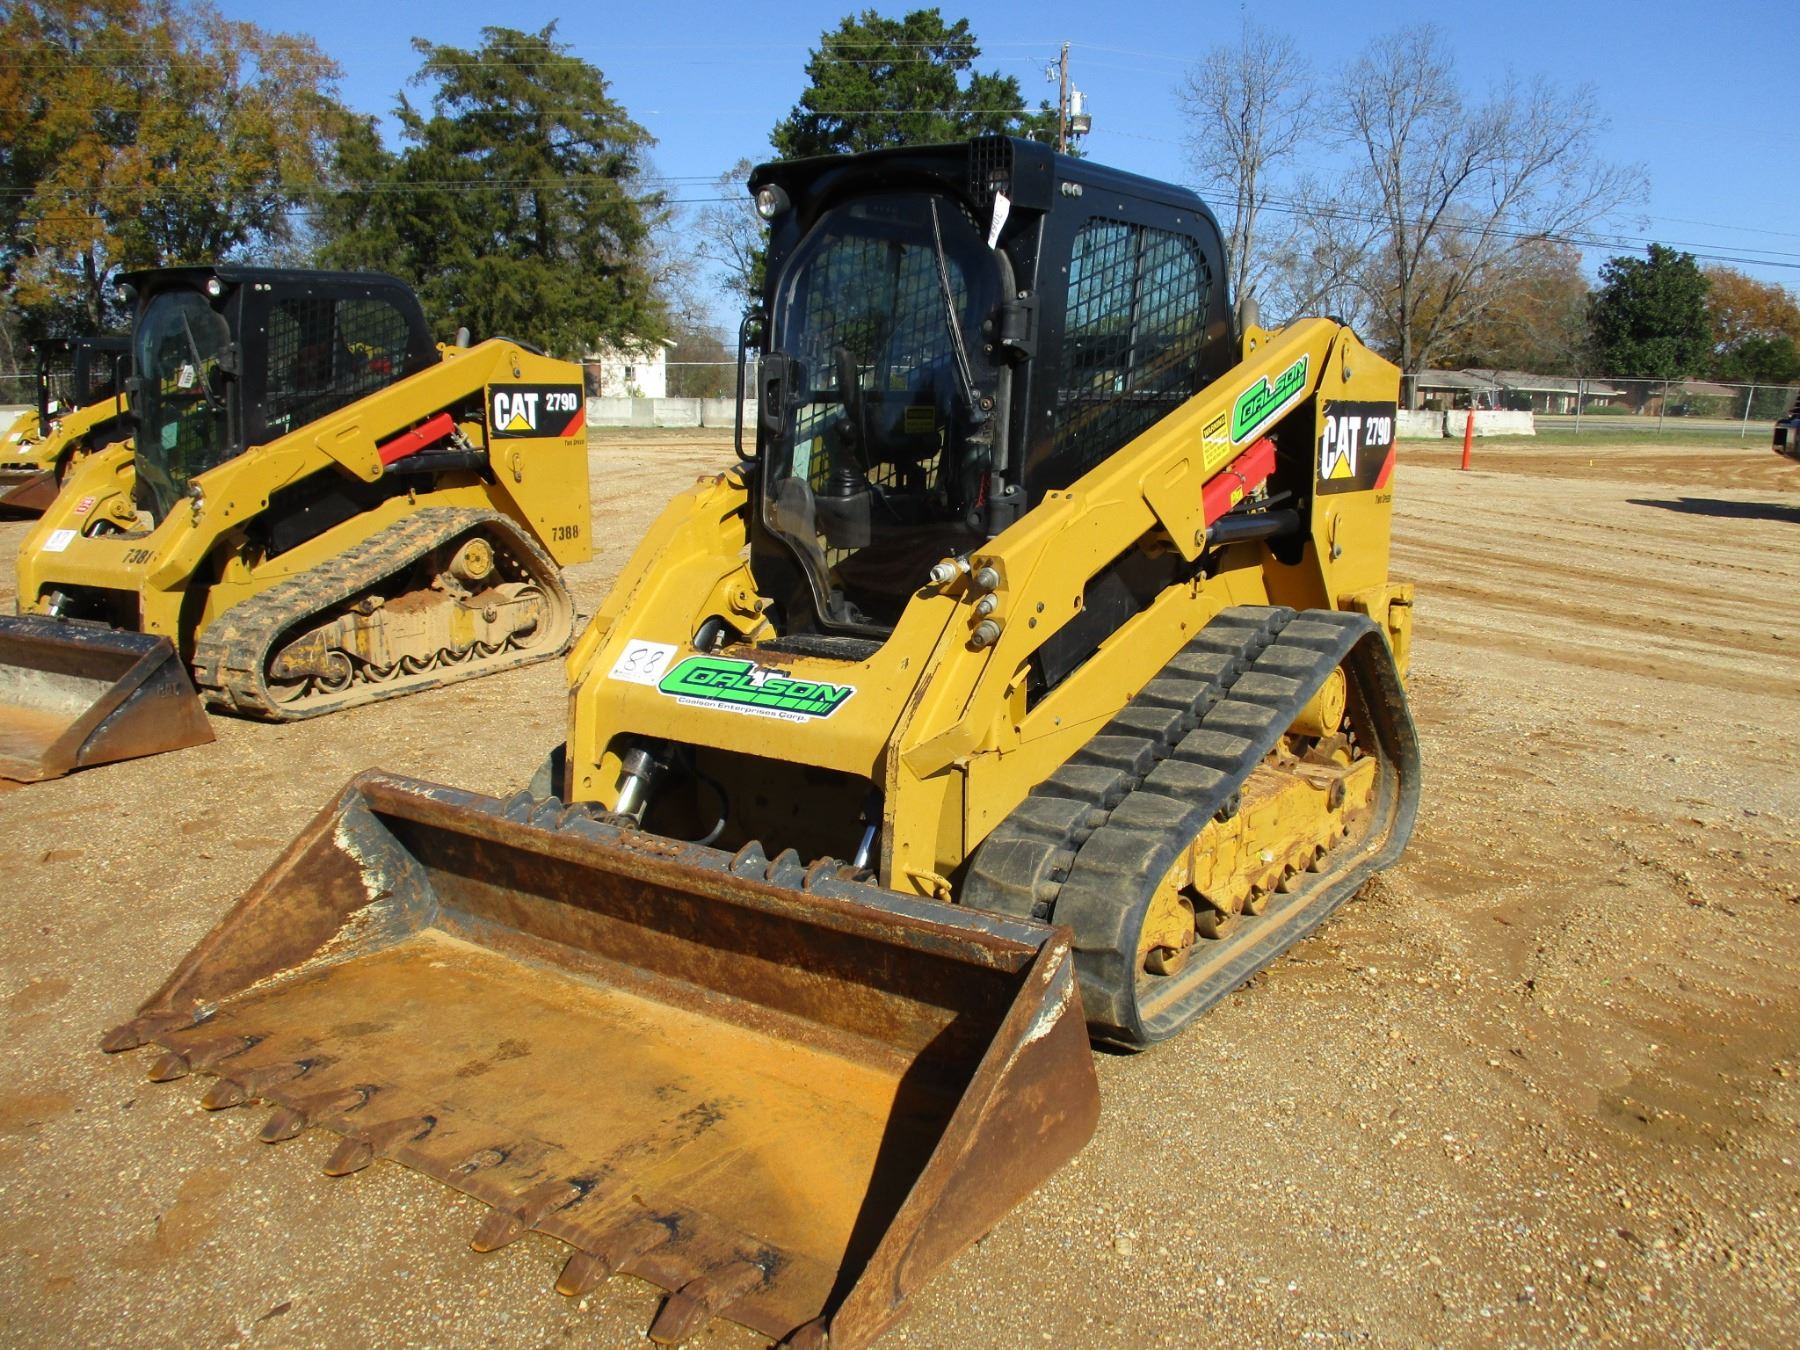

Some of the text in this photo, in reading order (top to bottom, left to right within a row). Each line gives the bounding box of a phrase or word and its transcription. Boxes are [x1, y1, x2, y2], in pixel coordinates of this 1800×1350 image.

[494, 392, 578, 431] CAT 279D
[1232, 356, 1308, 443] COALSON
[1321, 415, 1362, 481] CAT
[1365, 416, 1391, 446] 279D
[551, 524, 579, 542] 7388
[623, 648, 665, 674] 88
[659, 656, 854, 714] COALSON
[678, 696, 808, 722] Coalson Enterprises Corp.
